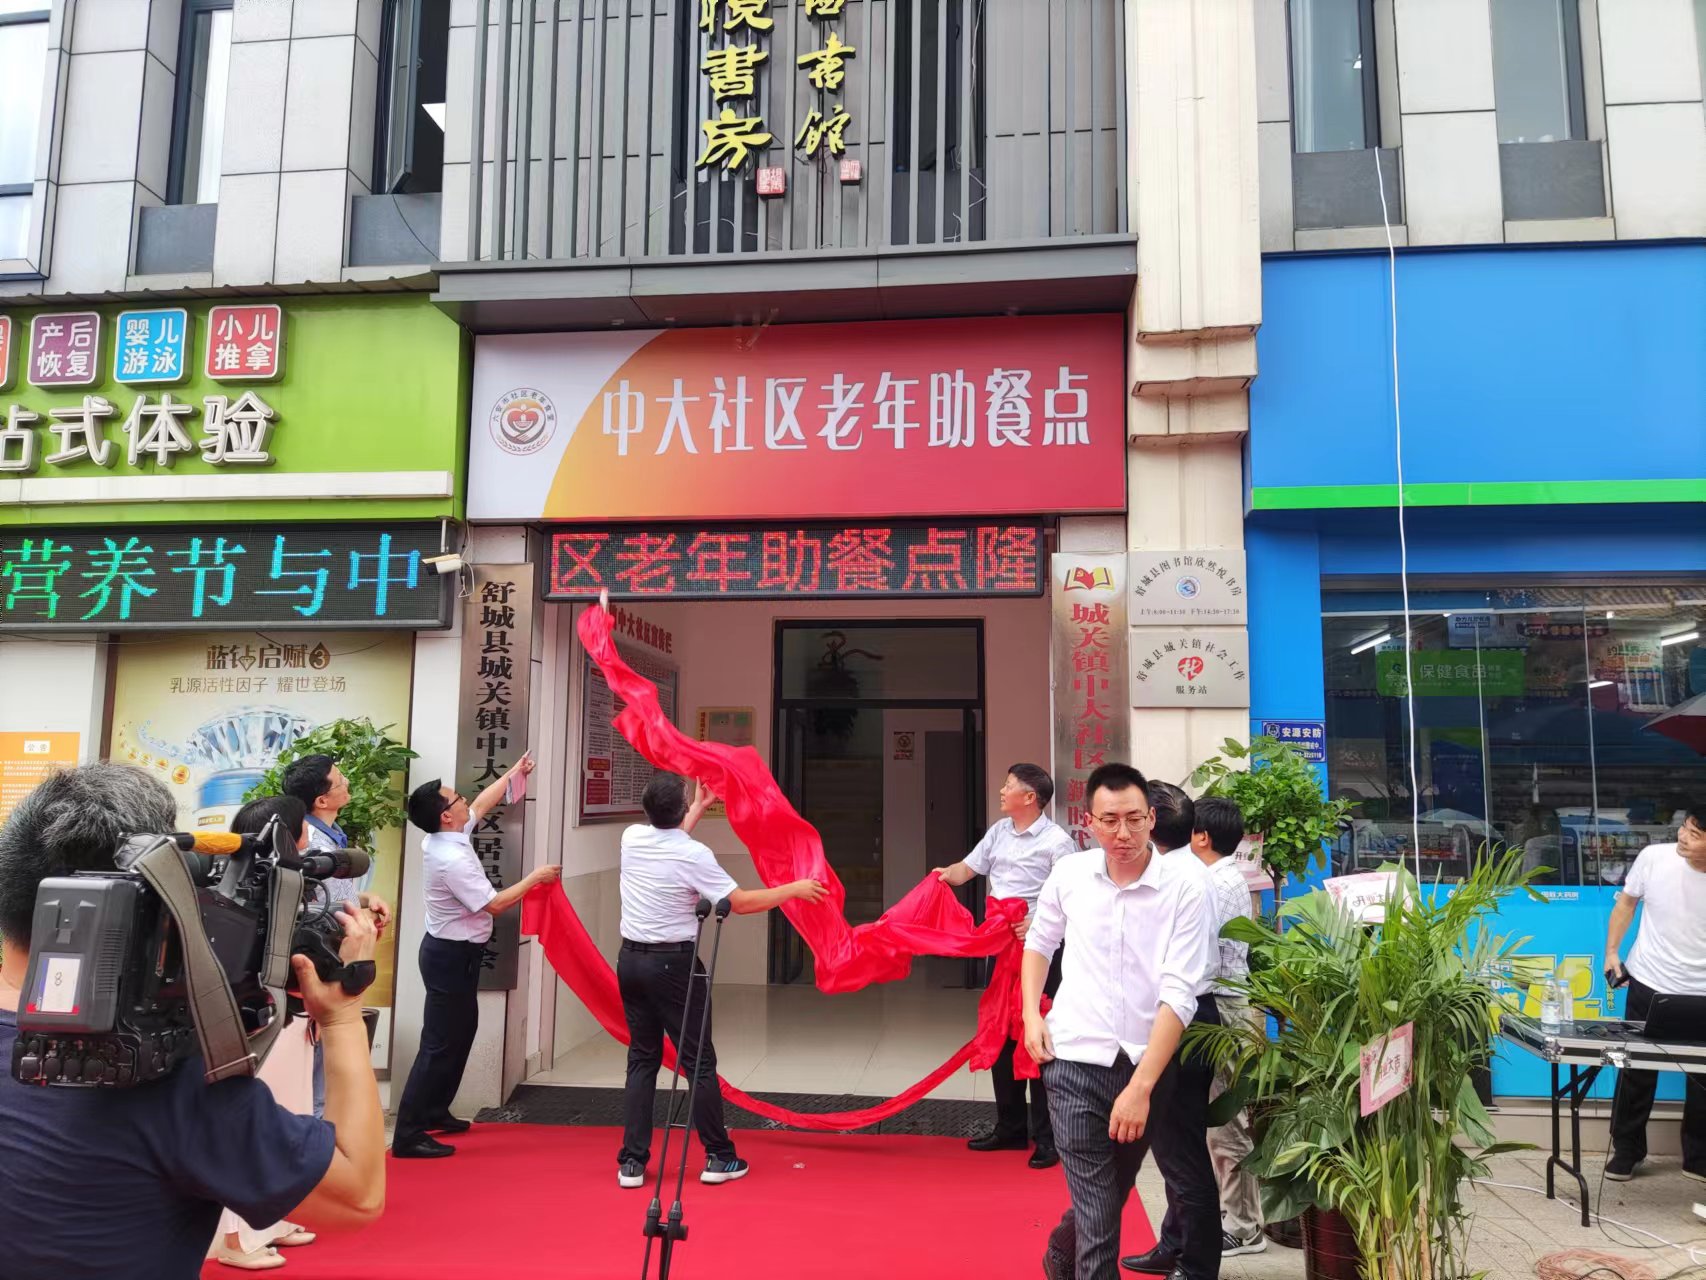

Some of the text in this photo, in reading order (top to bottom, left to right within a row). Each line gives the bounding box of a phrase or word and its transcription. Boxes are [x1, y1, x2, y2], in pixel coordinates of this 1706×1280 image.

[38, 321, 93, 349] 产后
[125, 318, 180, 346] 婴儿
[217, 314, 273, 342] 小儿
[37, 350, 90, 378] 恢复
[122, 346, 178, 375] 游泳
[215, 342, 272, 371] 推拿
[601, 365, 1091, 456] 中大社区老年助餐点
[551, 526, 1036, 595] 区老年助餐点隆
[2, 533, 421, 620] 营养节与中
[170, 676, 346, 693] 乳源活性因子 耀世登场
[1419, 664, 1487, 679] 保健食品
[1175, 685, 1208, 695] 服务站
[1281, 726, 1322, 738] 安源安防
